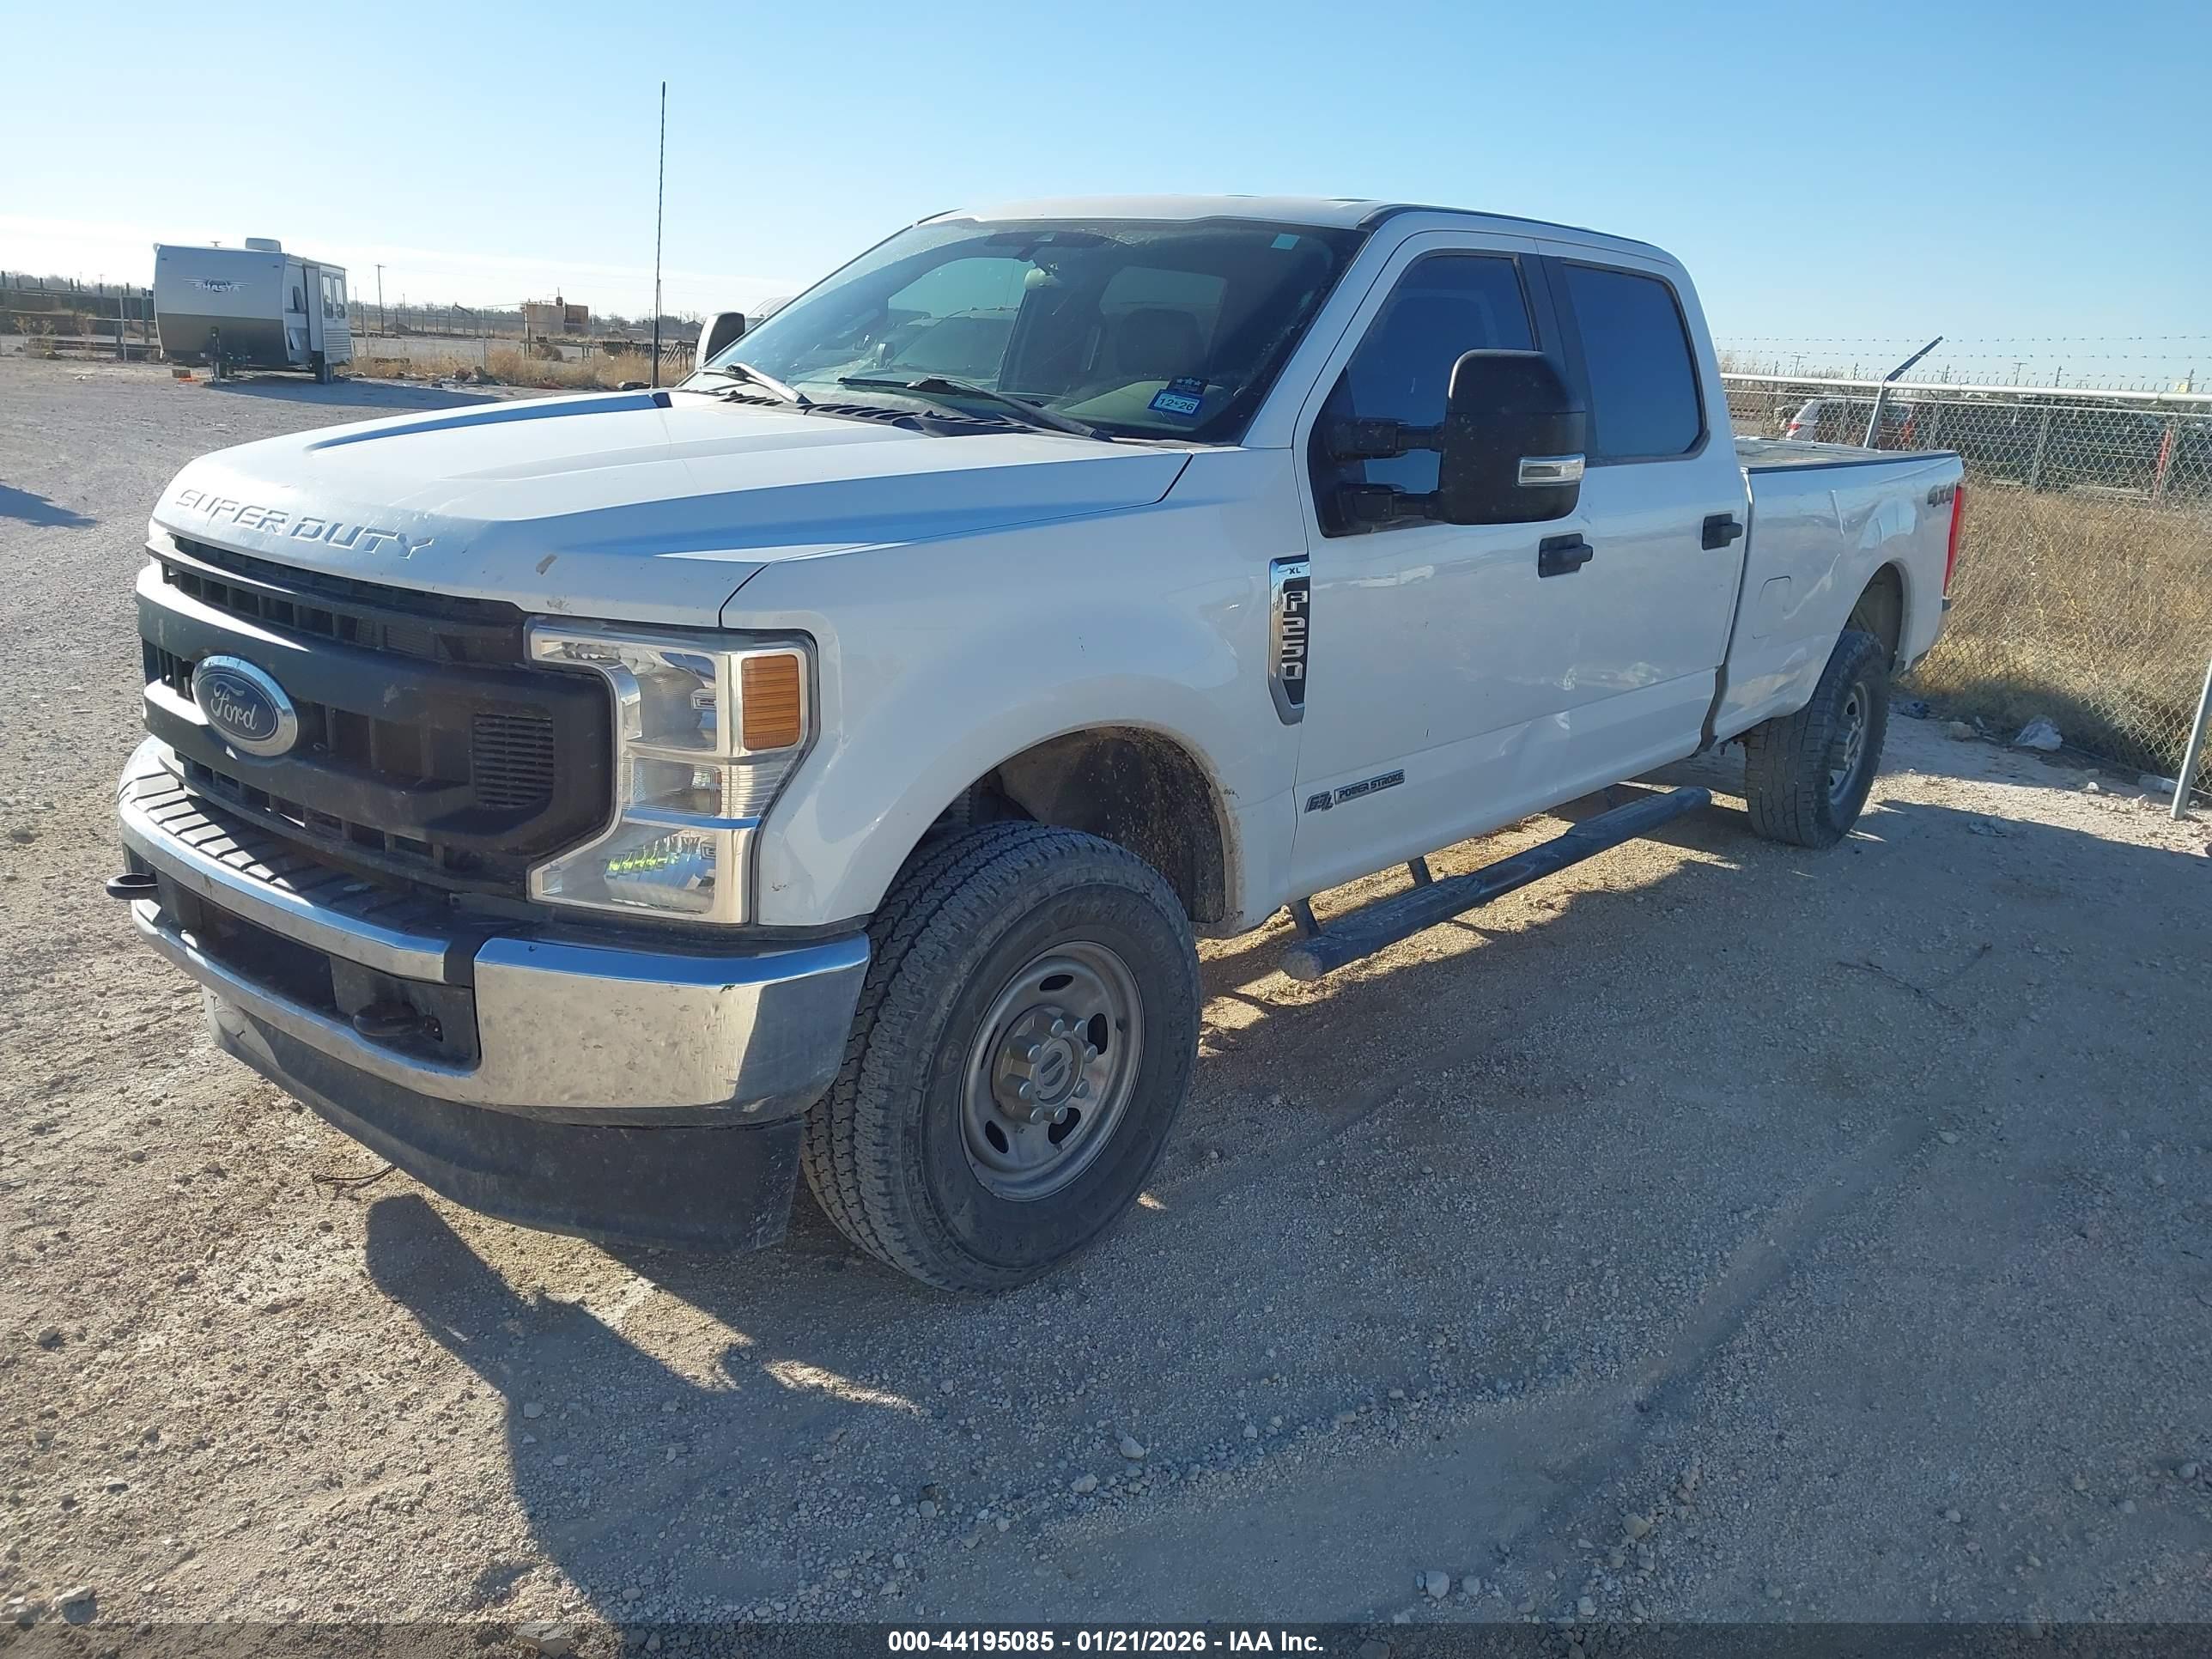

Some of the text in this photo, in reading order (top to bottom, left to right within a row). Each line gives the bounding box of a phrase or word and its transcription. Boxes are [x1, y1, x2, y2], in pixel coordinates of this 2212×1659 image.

[175, 489, 435, 561] SUPER DUTY
[1289, 567, 1302, 575] XL
[210, 681, 258, 731] Ford
[1339, 782, 1370, 799] POWER
[1370, 771, 1404, 789] STROKE
